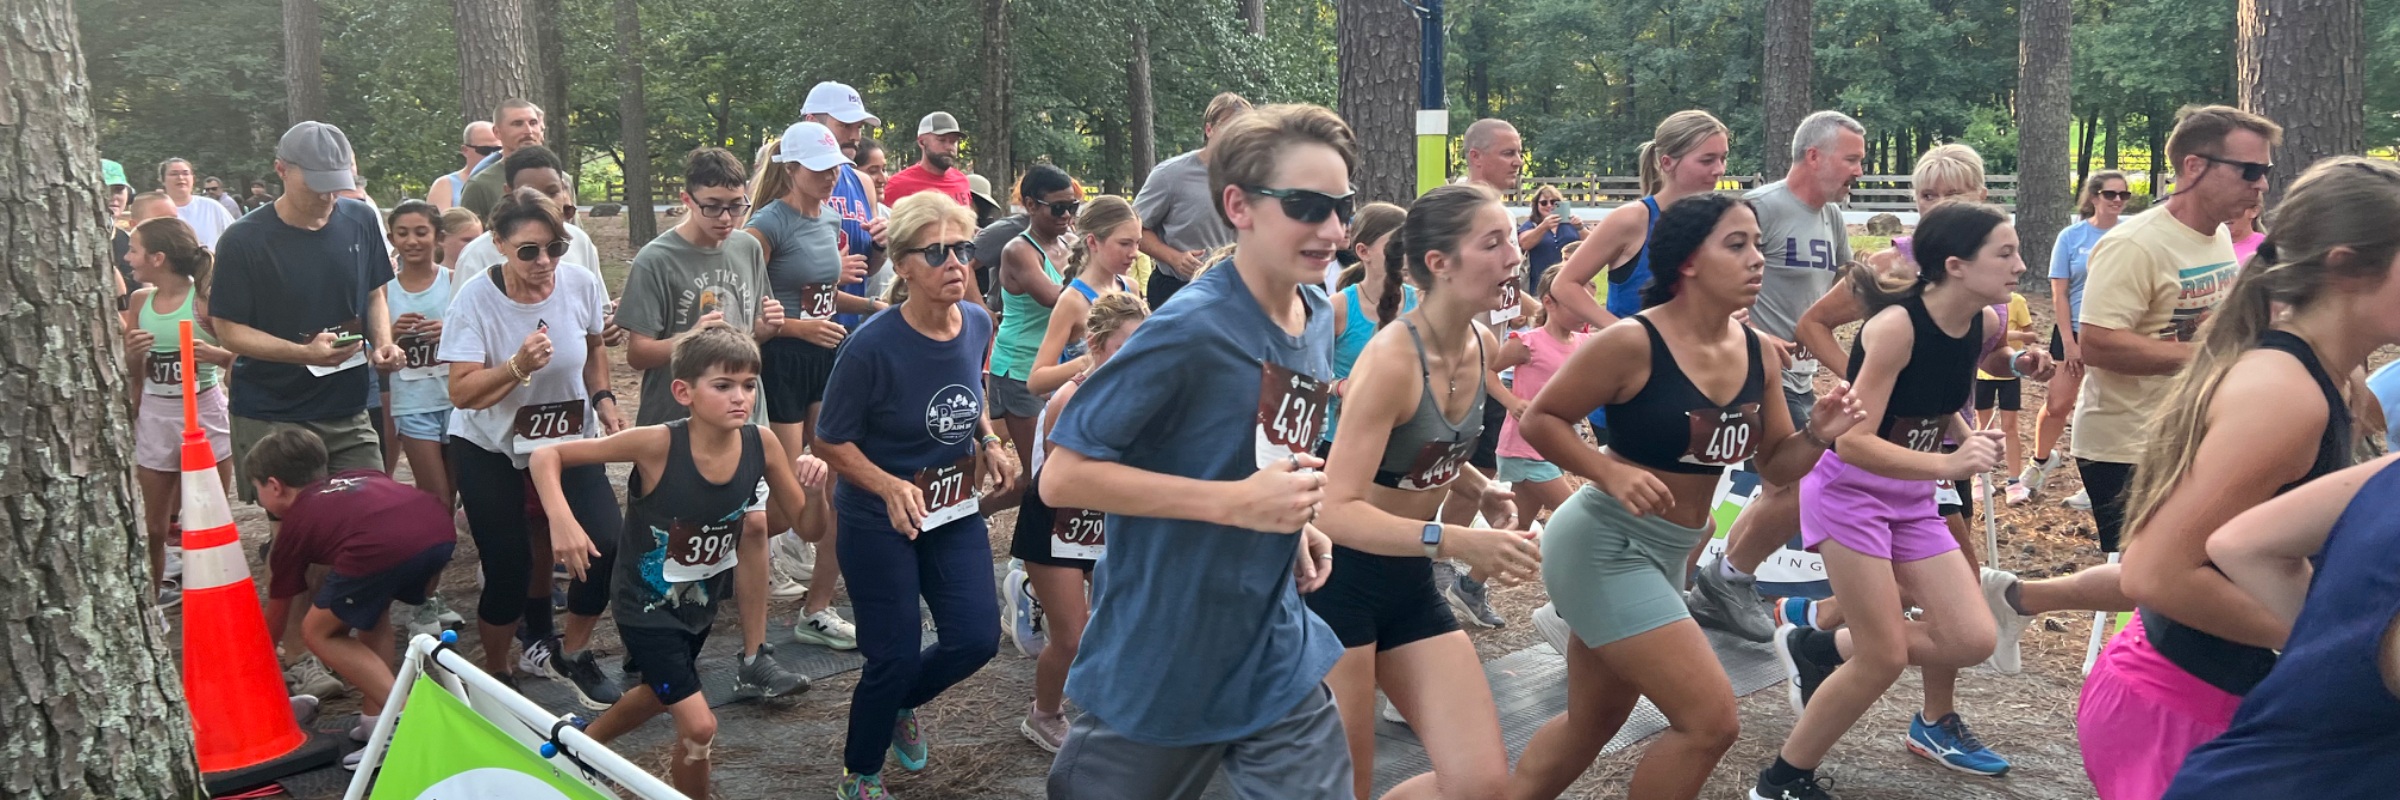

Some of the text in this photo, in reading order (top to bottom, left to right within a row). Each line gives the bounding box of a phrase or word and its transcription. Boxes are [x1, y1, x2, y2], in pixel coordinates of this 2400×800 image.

[676, 289, 696, 325] LAND
[693, 271, 710, 289] OF
[715, 268, 739, 286] THE
[1500, 285, 1515, 309] 29
[2178, 273, 2216, 300] RED
[153, 361, 183, 382] 378
[529, 410, 569, 437] 276
[1272, 392, 1317, 449] 436
[1705, 423, 1750, 460] 409
[1907, 427, 1939, 453] 373
[930, 472, 963, 509] 277
[1065, 517, 1103, 543] 379
[685, 533, 733, 563] 398
